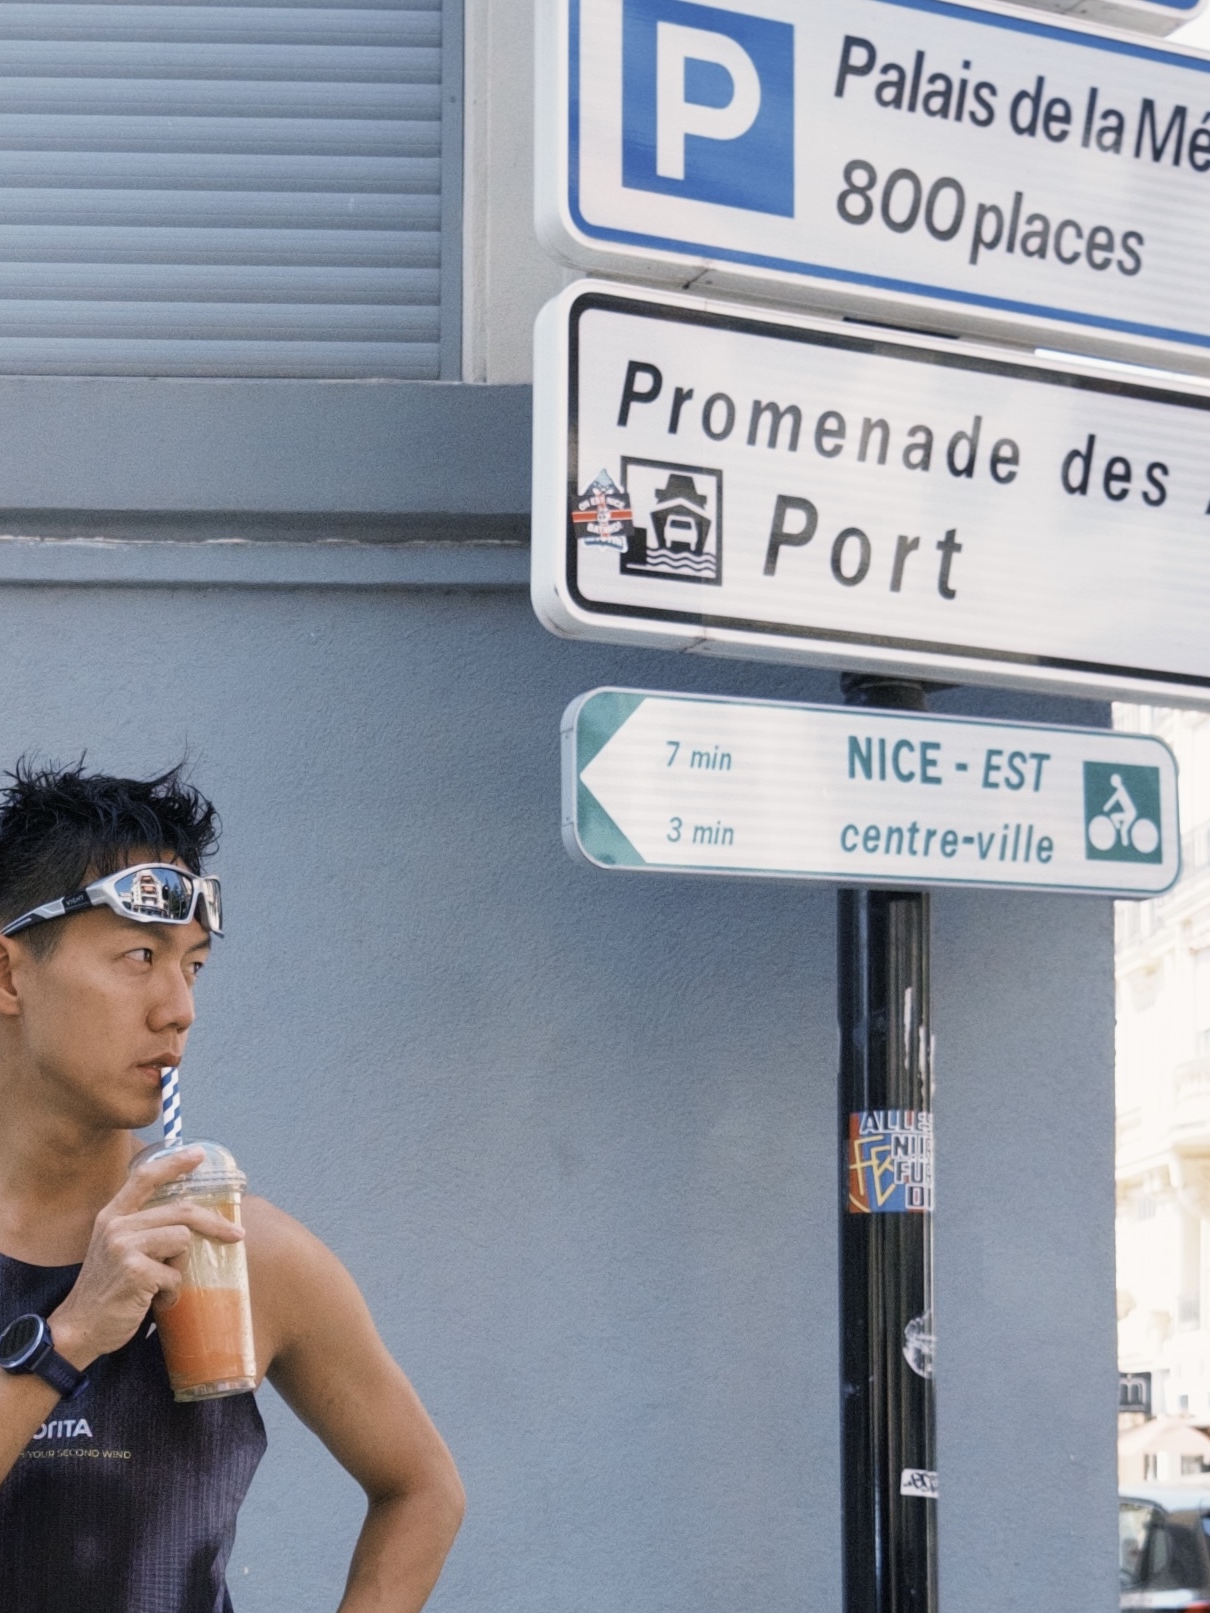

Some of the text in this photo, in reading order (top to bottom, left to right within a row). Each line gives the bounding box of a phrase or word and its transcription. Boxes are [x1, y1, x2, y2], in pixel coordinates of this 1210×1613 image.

[656, 20, 761, 180] P
[834, 35, 998, 127] Palais
[1009, 75, 1072, 142] de
[1080, 86, 1124, 154] la
[836, 158, 1145, 277] 800 places
[616, 358, 1170, 507] Promenade des
[762, 494, 964, 600] Port
[666, 741, 733, 771] 7 min
[847, 735, 943, 785] NICE
[981, 748, 1052, 793] EST
[666, 817, 735, 847] 3 min
[840, 820, 1055, 864] centre-ville
